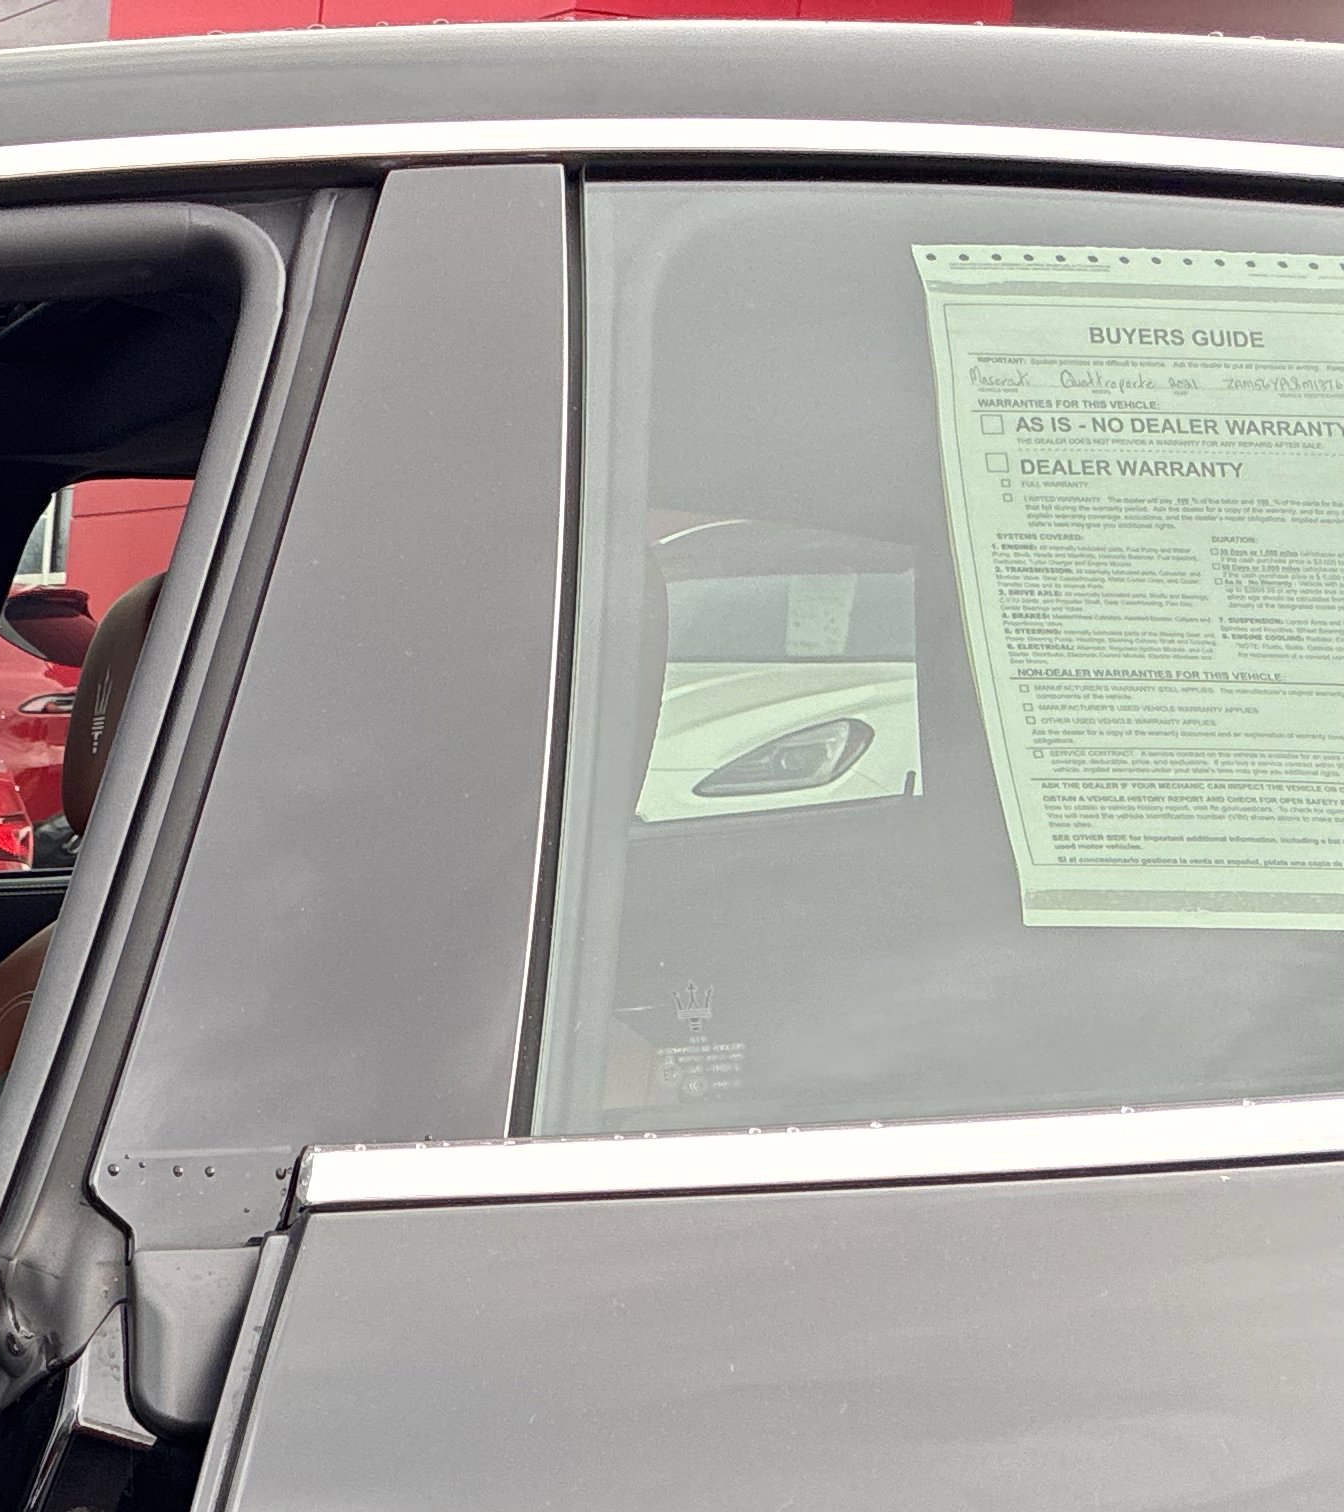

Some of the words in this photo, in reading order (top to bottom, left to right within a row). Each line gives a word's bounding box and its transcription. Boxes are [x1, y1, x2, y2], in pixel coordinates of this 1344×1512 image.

[1089, 327, 1184, 346] BUYERS
[1192, 330, 1264, 348] GUIDE
[978, 400, 1052, 408] WARRANTIES
[1055, 400, 1078, 409] FOR
[1082, 401, 1106, 409] THIS
[1016, 417, 1045, 433] AS
[1051, 417, 1073, 433] IS
[1092, 418, 1124, 434] NO
[1130, 418, 1218, 434] DEALER
[1223, 420, 1344, 437] WARRANTY
[1021, 459, 1110, 476] DEALER
[1117, 460, 1243, 478] WARRANTY
[1018, 668, 1090, 677] NON-DEALER
[1093, 670, 1172, 679] WARRANTIES
[1203, 672, 1228, 680] THIS
